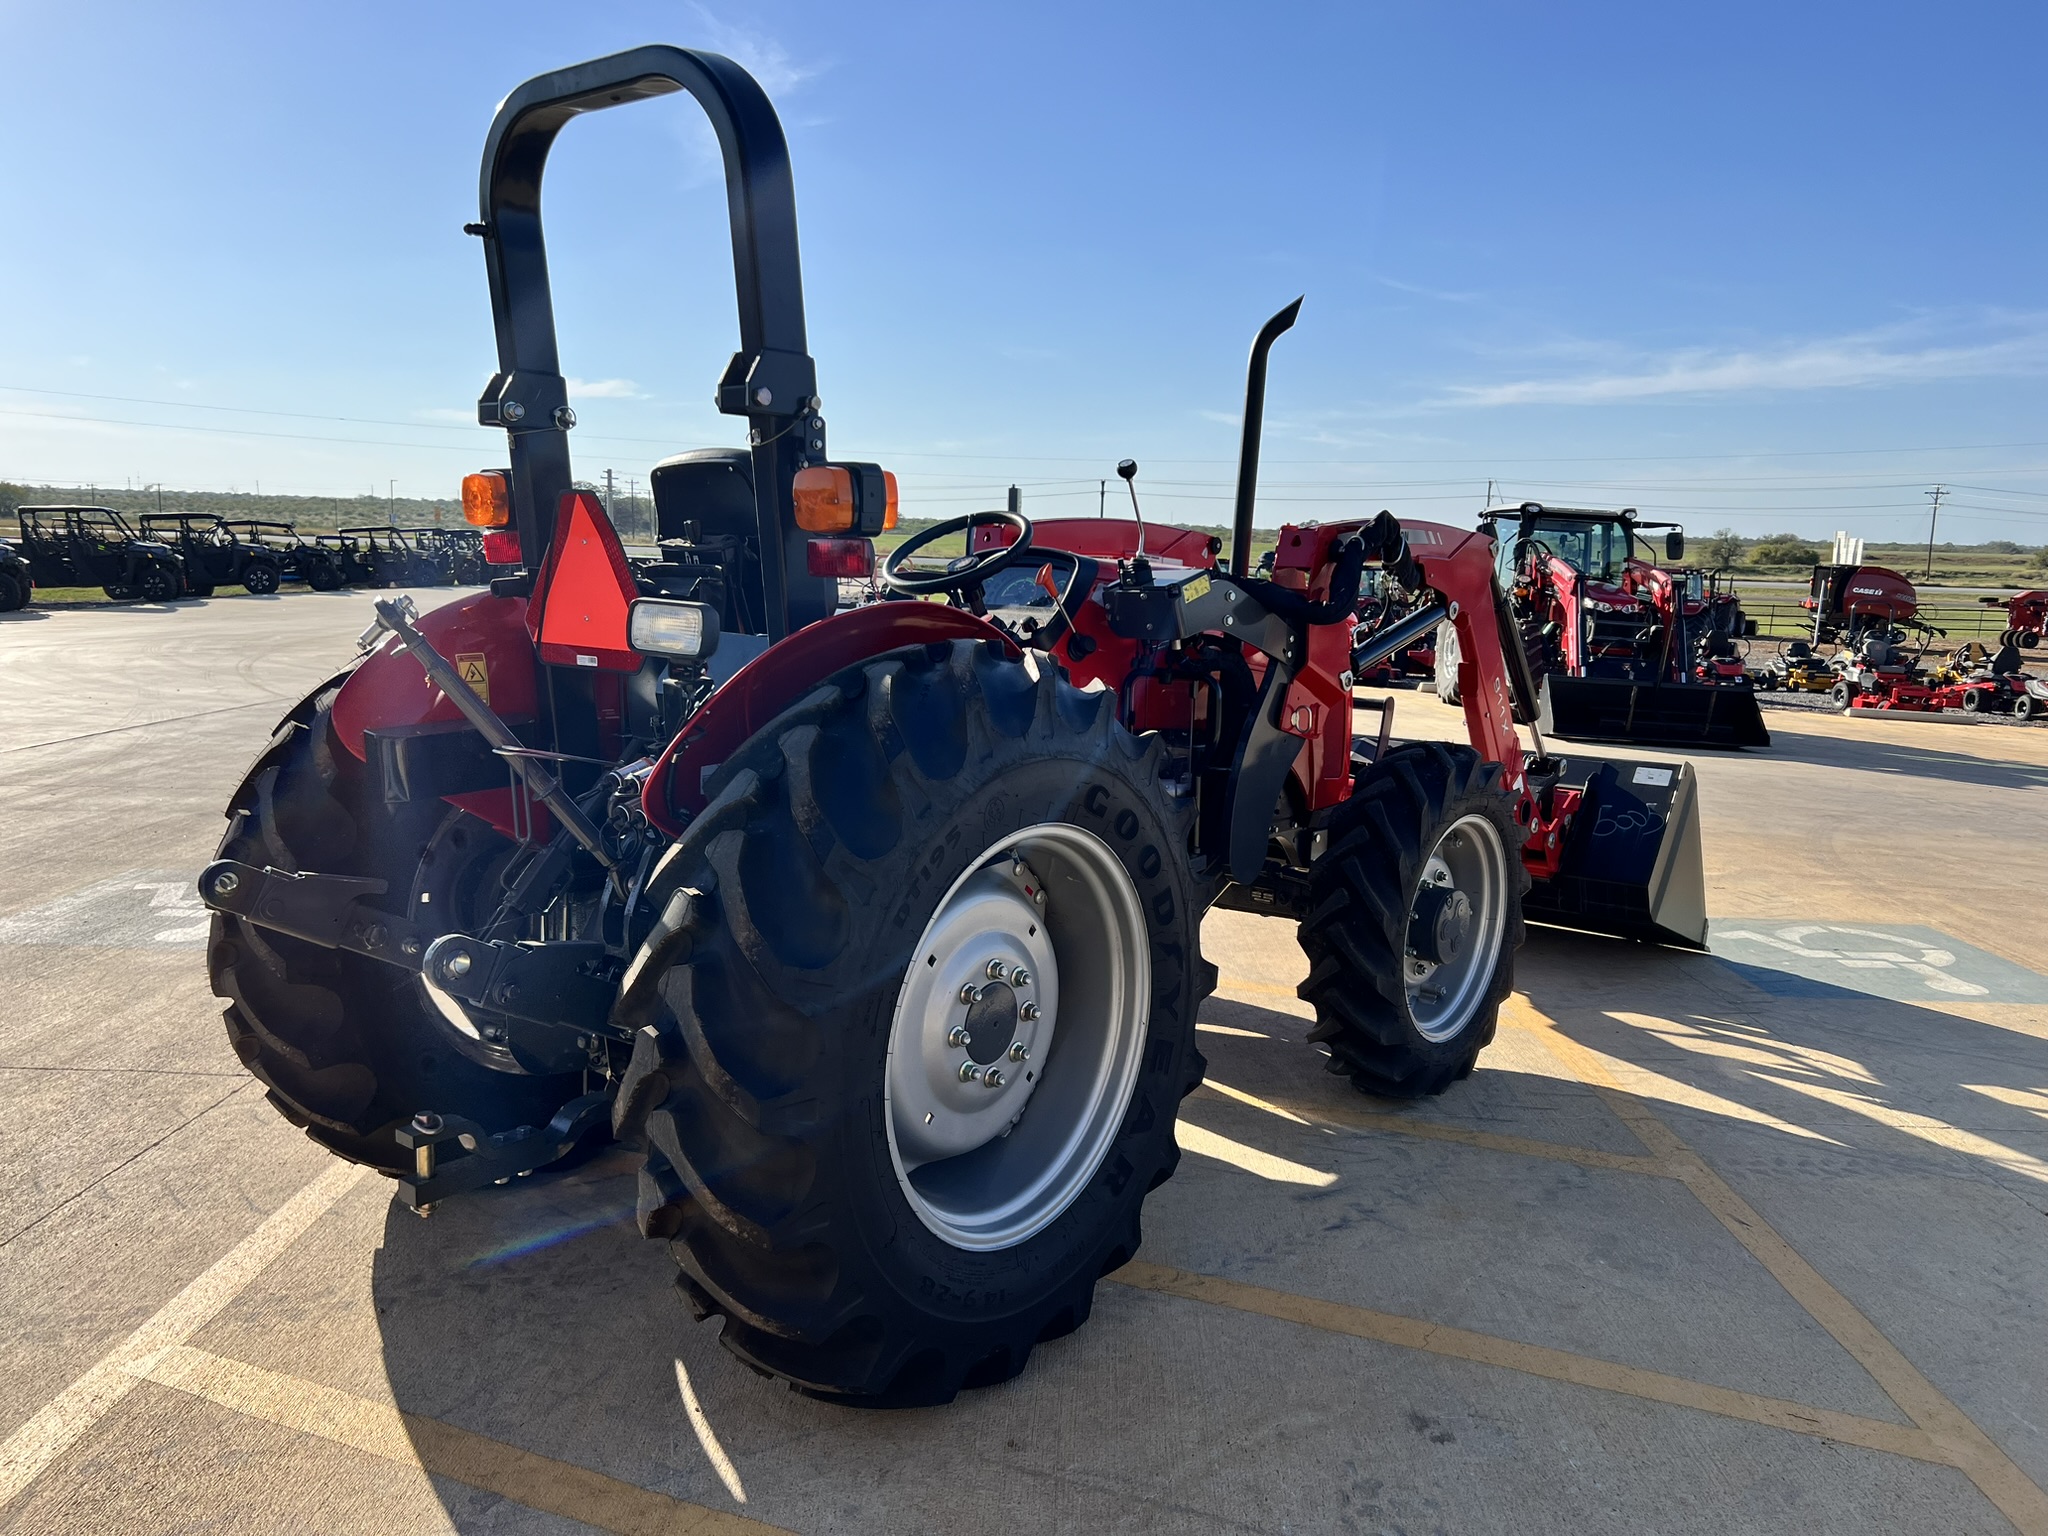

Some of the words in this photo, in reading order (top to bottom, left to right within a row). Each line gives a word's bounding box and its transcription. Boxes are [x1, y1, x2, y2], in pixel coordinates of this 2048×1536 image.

[1852, 587, 1874, 595] CASE
[1493, 676, 1509, 736] 911X
[1084, 783, 1180, 1198] GOODYEAR
